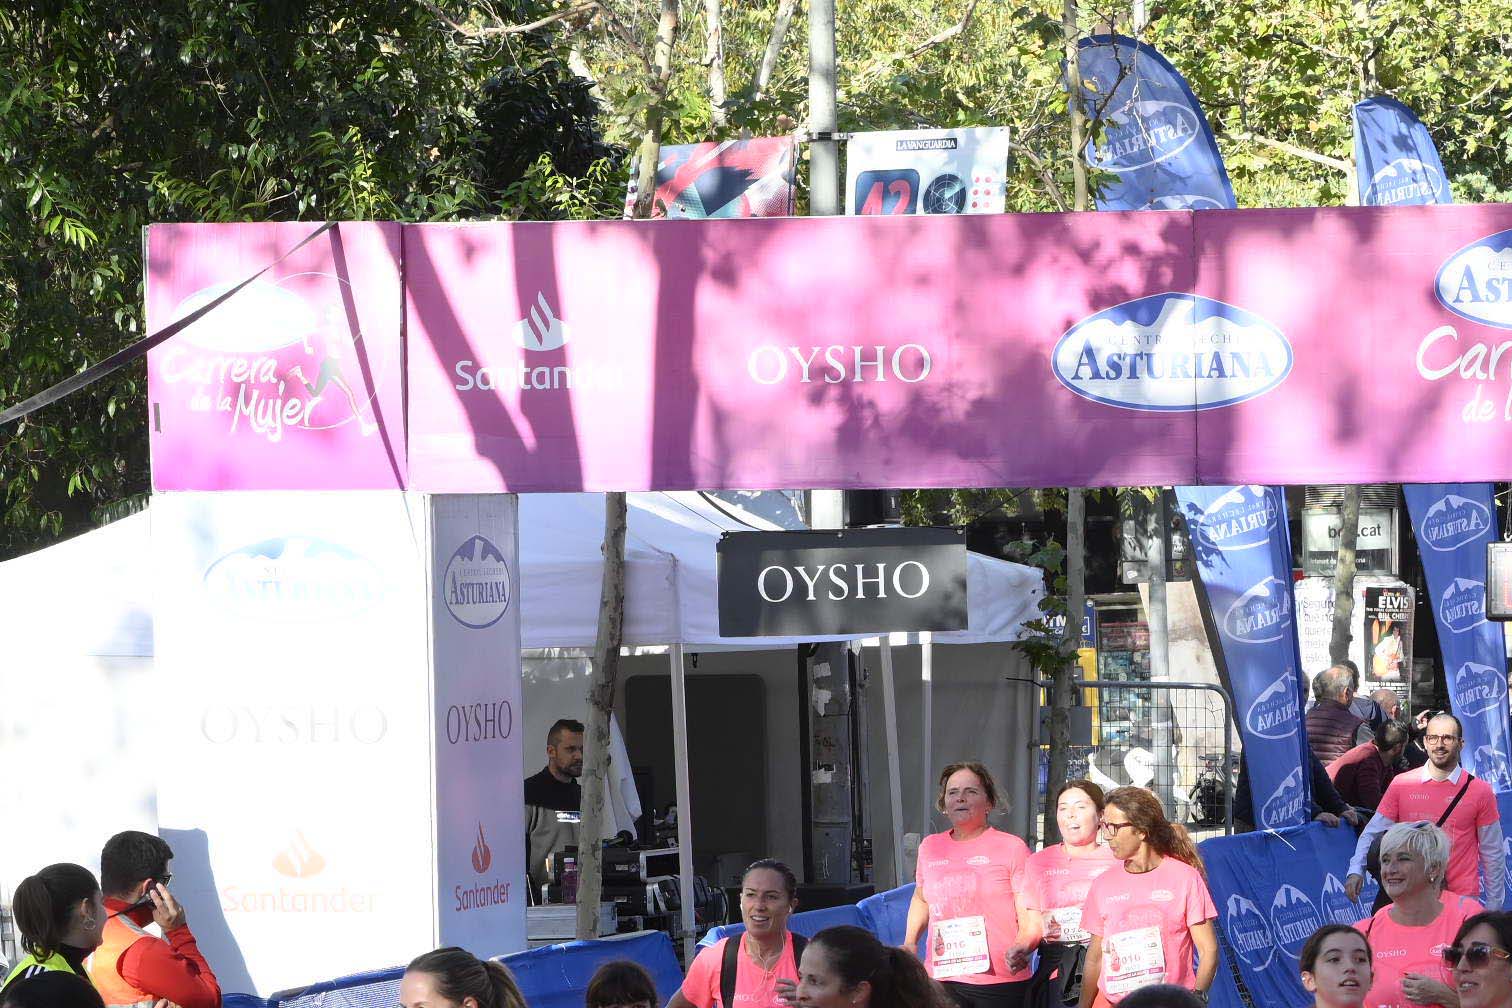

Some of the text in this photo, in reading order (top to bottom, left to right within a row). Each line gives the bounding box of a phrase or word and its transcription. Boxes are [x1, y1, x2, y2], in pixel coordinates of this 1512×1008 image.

[746, 343, 932, 386] OYSHO
[1070, 338, 1276, 381] ASTURIANA
[229, 380, 325, 443] Mujer
[1462, 383, 1496, 422] de
[449, 571, 507, 606] ASTURIANA
[758, 561, 931, 603] OYSHO
[1378, 596, 1409, 609] ELVIS
[201, 705, 388, 745] OYSHO
[446, 701, 513, 745] OYSHO
[455, 881, 511, 913] Santander
[1377, 949, 1408, 960] OYSHO
